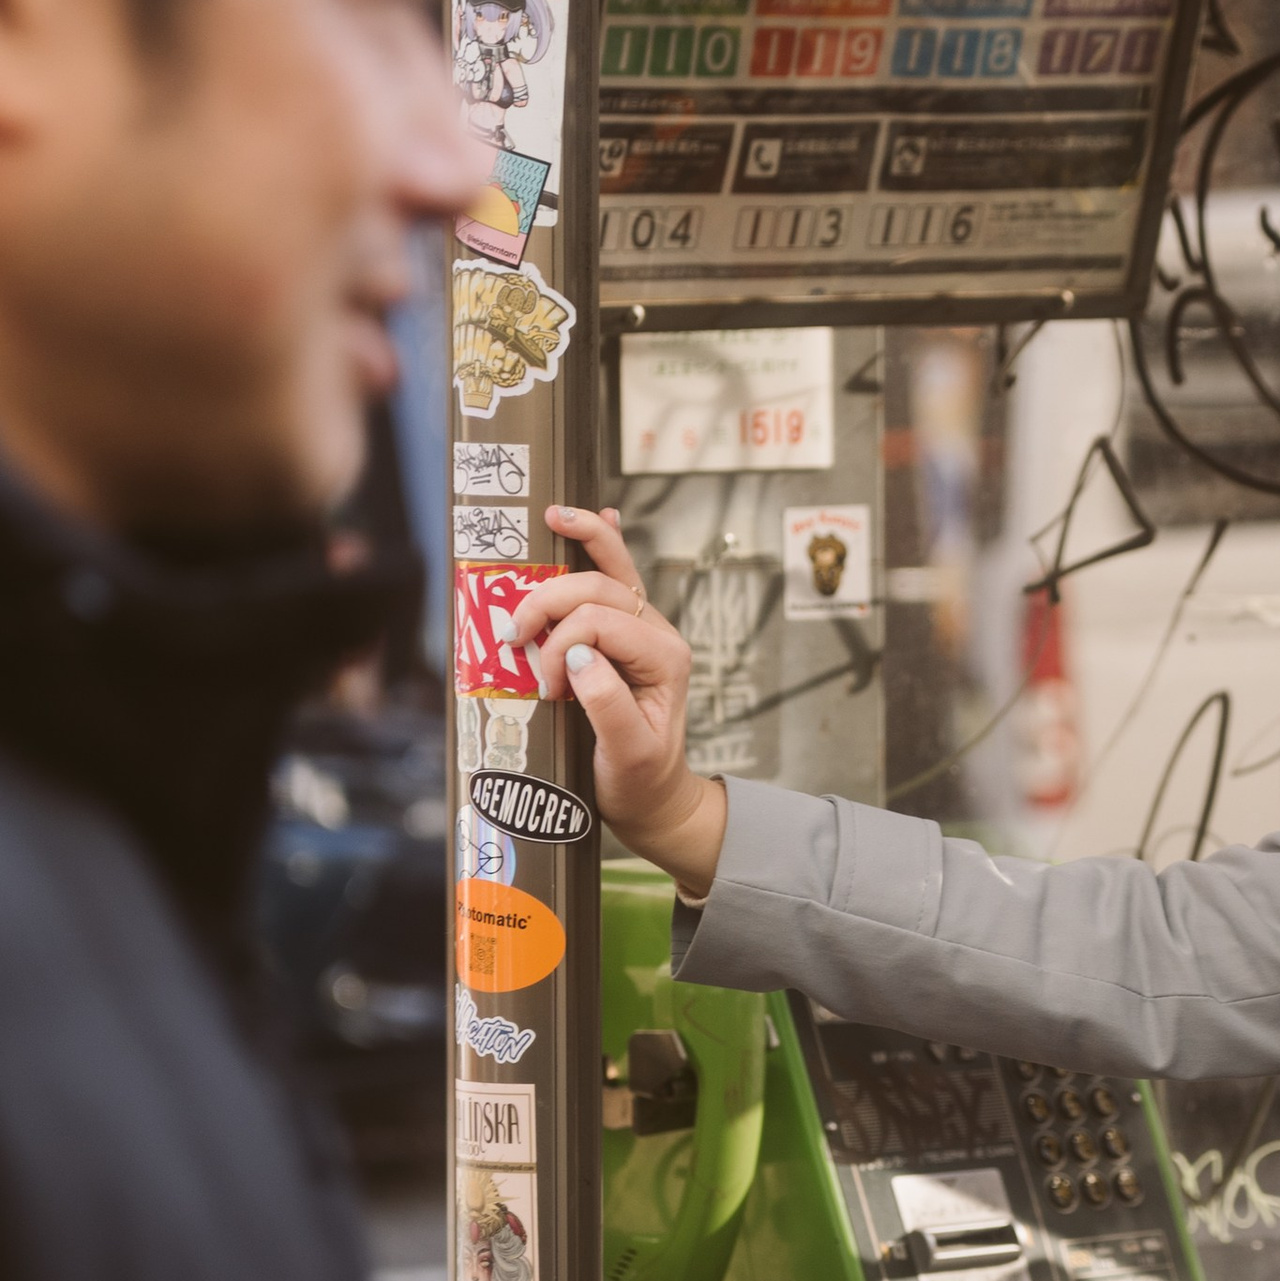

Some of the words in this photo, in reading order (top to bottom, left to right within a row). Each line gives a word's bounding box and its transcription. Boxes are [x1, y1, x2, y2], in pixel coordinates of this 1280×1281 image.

[618, 31, 734, 72] 110
[765, 32, 878, 73] 119
[907, 30, 1015, 72] 118
[748, 208, 843, 249] 113
[881, 205, 973, 243] 116
[472, 777, 585, 835] AGEMOCREW
